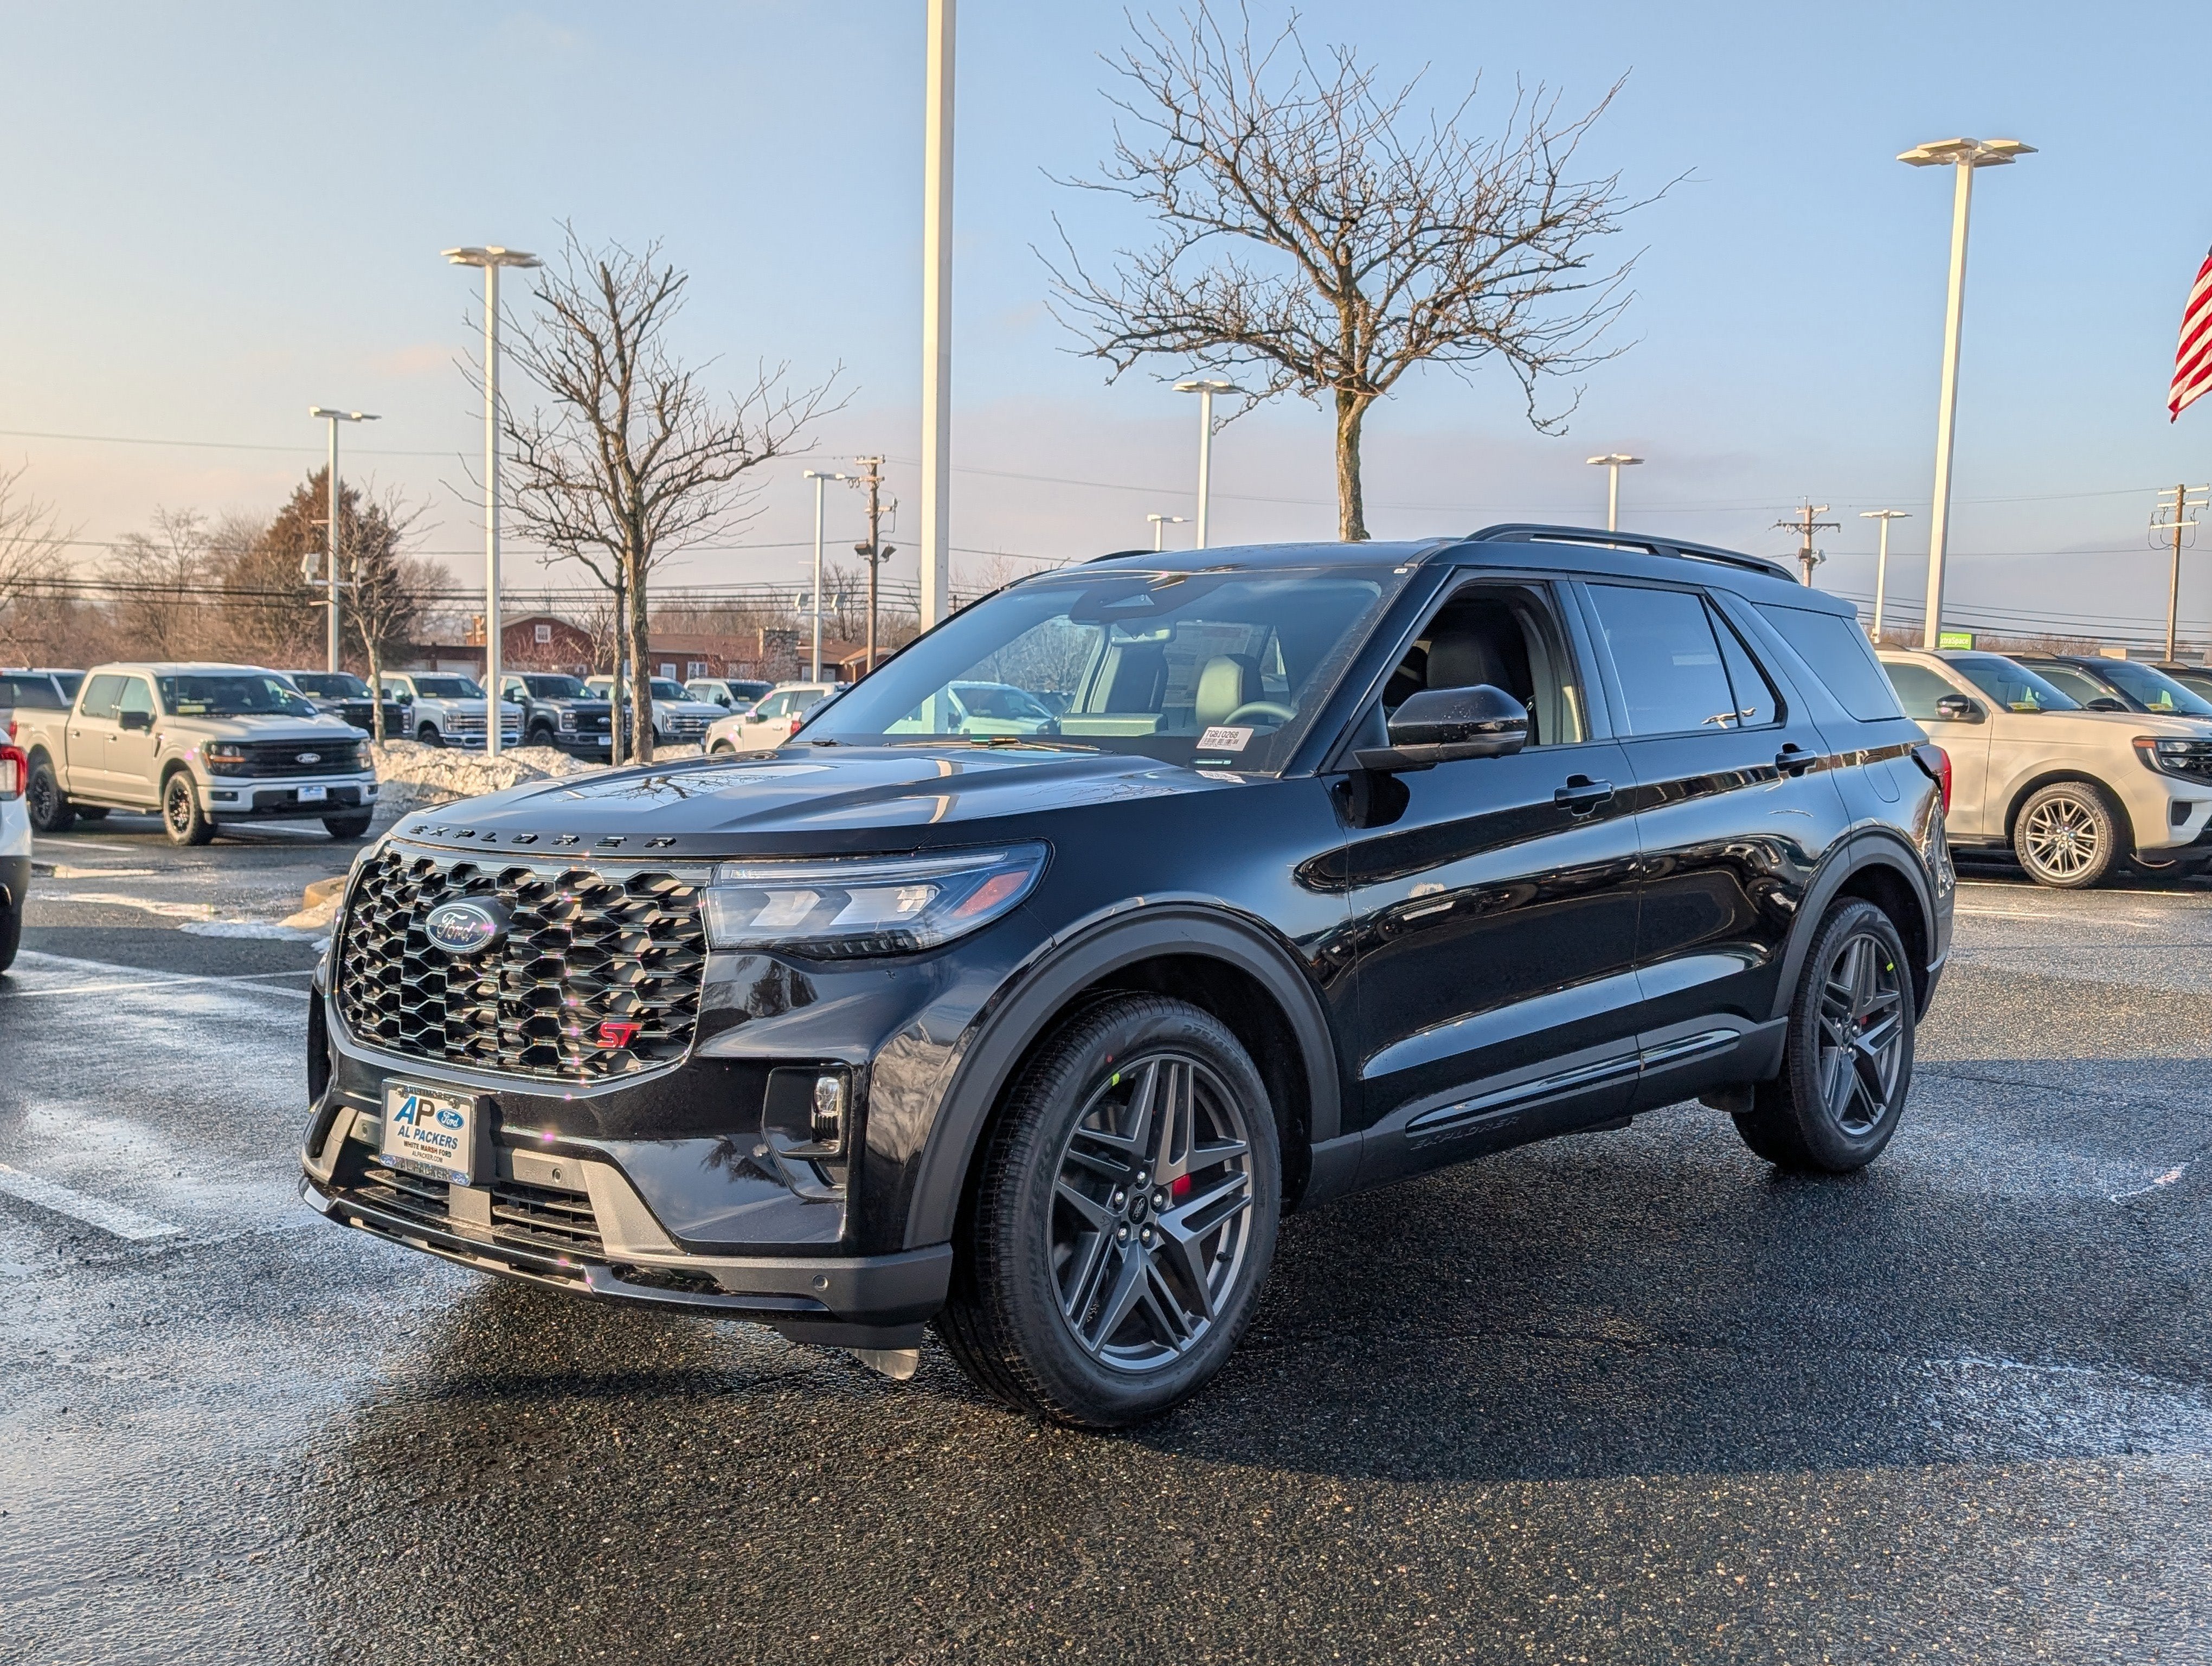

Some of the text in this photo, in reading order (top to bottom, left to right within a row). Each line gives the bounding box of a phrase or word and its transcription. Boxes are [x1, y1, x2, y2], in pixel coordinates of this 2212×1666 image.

[1940, 637, 1969, 645] xtraSpace
[409, 824, 677, 849] EXPLORER
[436, 912, 477, 942] Ford
[596, 1022, 642, 1048] ST
[393, 1095, 435, 1127] AP
[441, 1111, 459, 1127] Ford
[397, 1125, 458, 1150] AL PACKERS
[1410, 1117, 1519, 1150] EXPLORER
[403, 1140, 452, 1158] WHITE MARSH FORD
